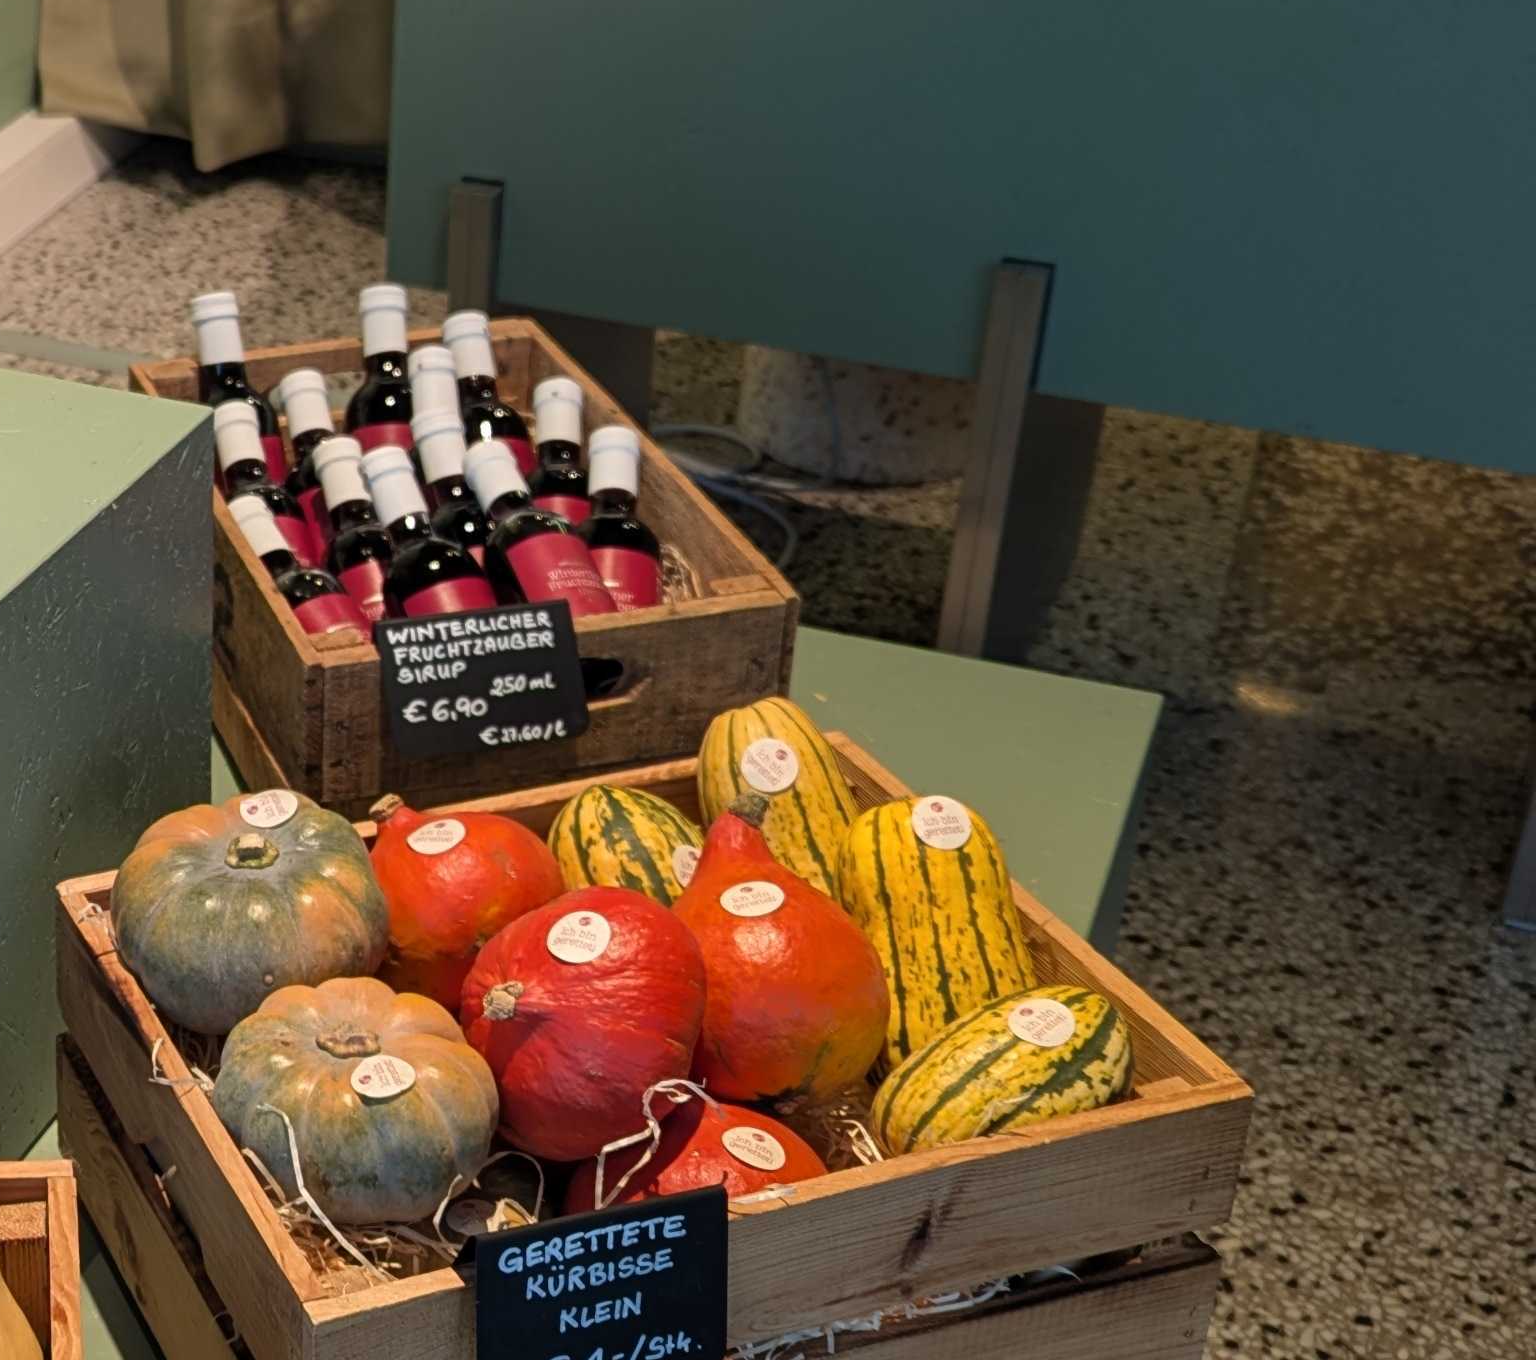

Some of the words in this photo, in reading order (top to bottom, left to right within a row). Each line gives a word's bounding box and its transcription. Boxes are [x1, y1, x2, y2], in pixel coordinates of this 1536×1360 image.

[386, 609, 553, 646] WINTERLICHER
[393, 631, 555, 666] FRUCHTZAUBER
[396, 660, 467, 684] SIRUP
[498, 1214, 687, 1274] GERETTETE
[525, 1248, 675, 1301] KÜRBISSE
[559, 1291, 643, 1334] KLEIN
